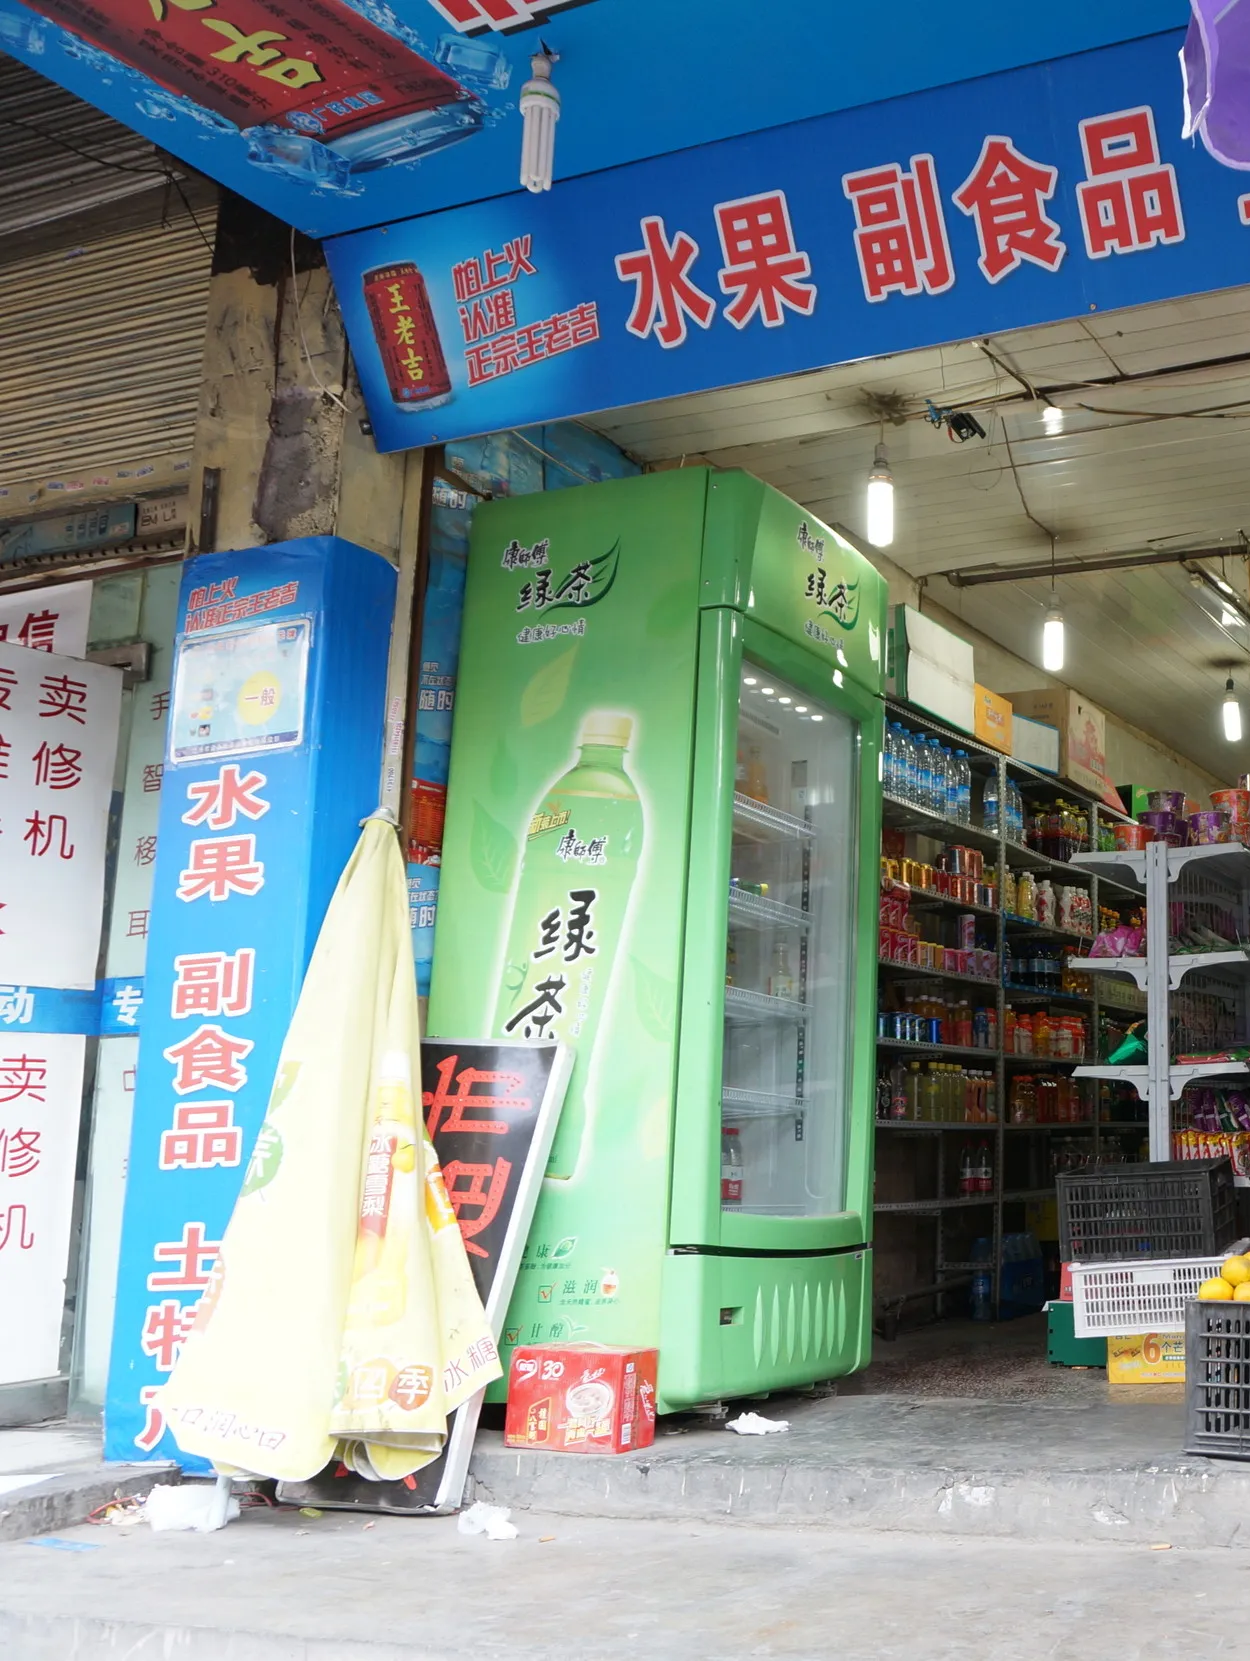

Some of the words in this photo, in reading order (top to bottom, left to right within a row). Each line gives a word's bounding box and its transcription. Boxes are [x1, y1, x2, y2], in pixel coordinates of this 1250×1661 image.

[615, 190, 817, 349] 水果
[842, 105, 1186, 303] 副食品
[452, 234, 537, 303] 怕上火
[387, 283, 424, 381] 王老吉
[458, 289, 516, 344] 认准
[465, 301, 600, 388] 正宗王老吉
[185, 581, 299, 635] 认准正宗王老吉
[188, 576, 239, 611] 怕上火
[516, 560, 594, 612] 绿茶
[805, 567, 849, 622] 绿茶
[177, 764, 270, 902] 水果
[503, 888, 597, 1040] 绿茶
[159, 947, 255, 1171] 副食品
[361, 1134, 393, 1217] 冰糖雪梨
[1143, 1333, 1162, 1364] 6
